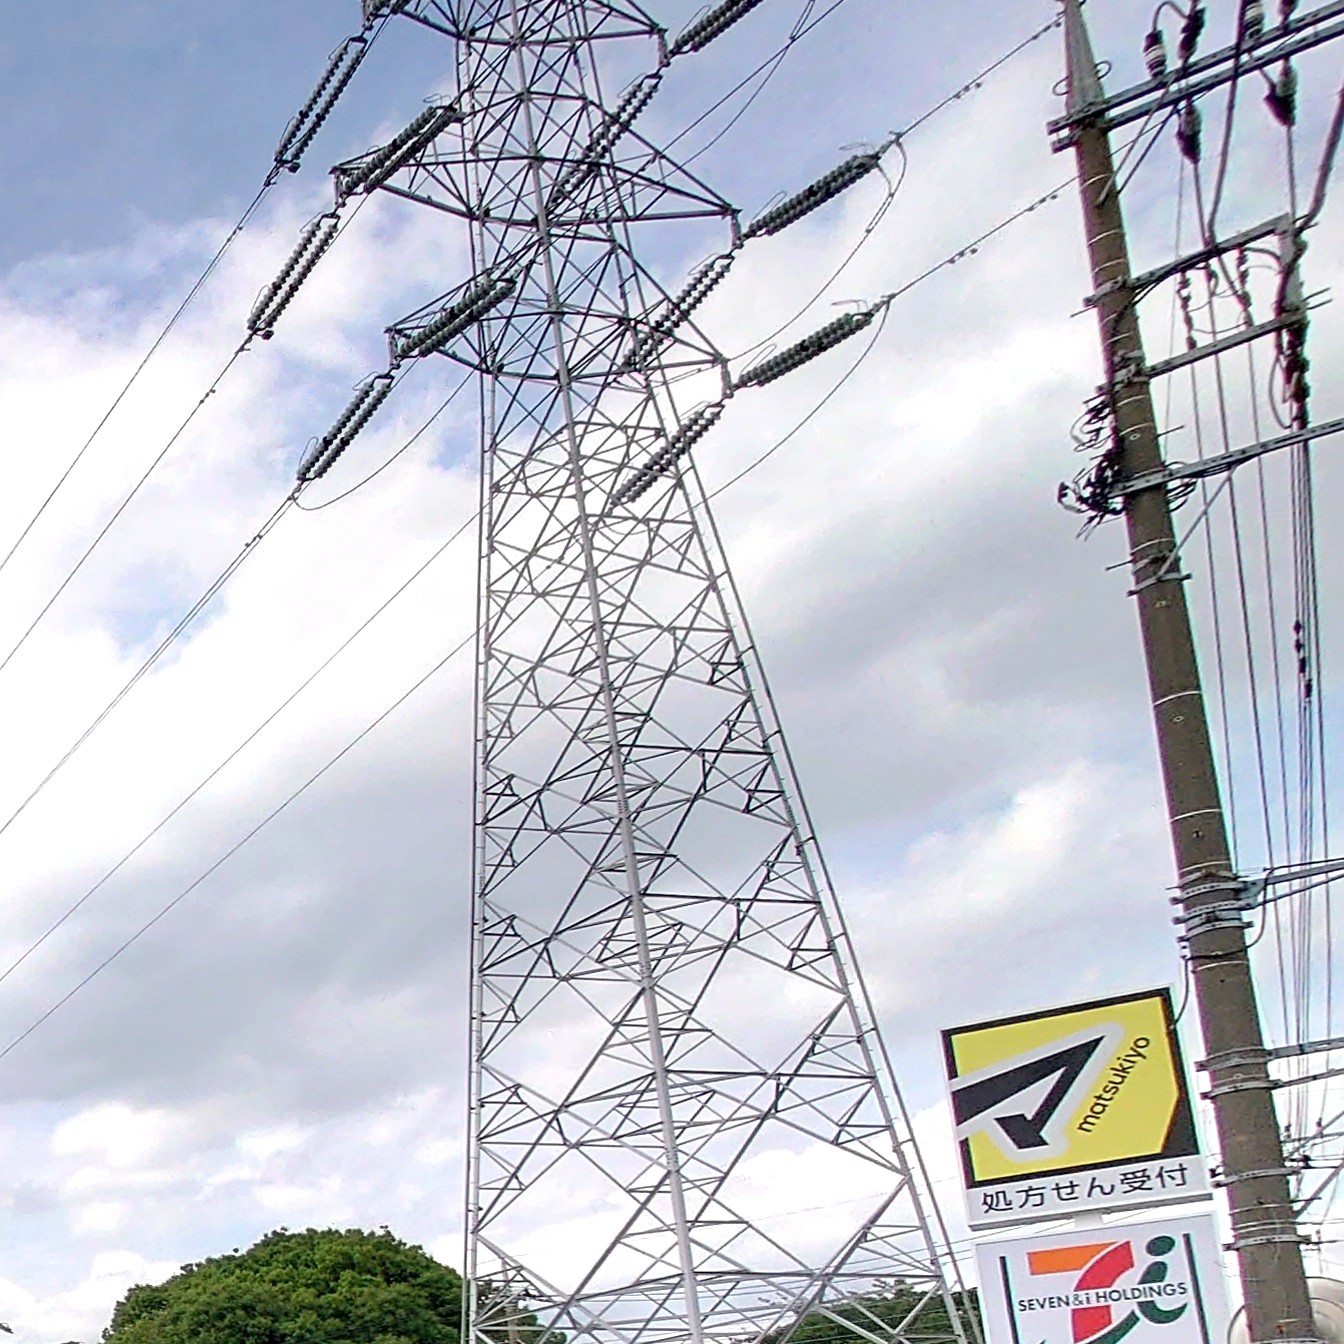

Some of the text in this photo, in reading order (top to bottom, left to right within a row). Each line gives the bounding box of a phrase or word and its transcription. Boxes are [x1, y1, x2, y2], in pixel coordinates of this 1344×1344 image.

[1077, 1036, 1150, 1133] matsukiyo
[982, 1162, 1188, 1214] 処方せん受付
[1096, 1282, 1188, 1303] HOLDINGS
